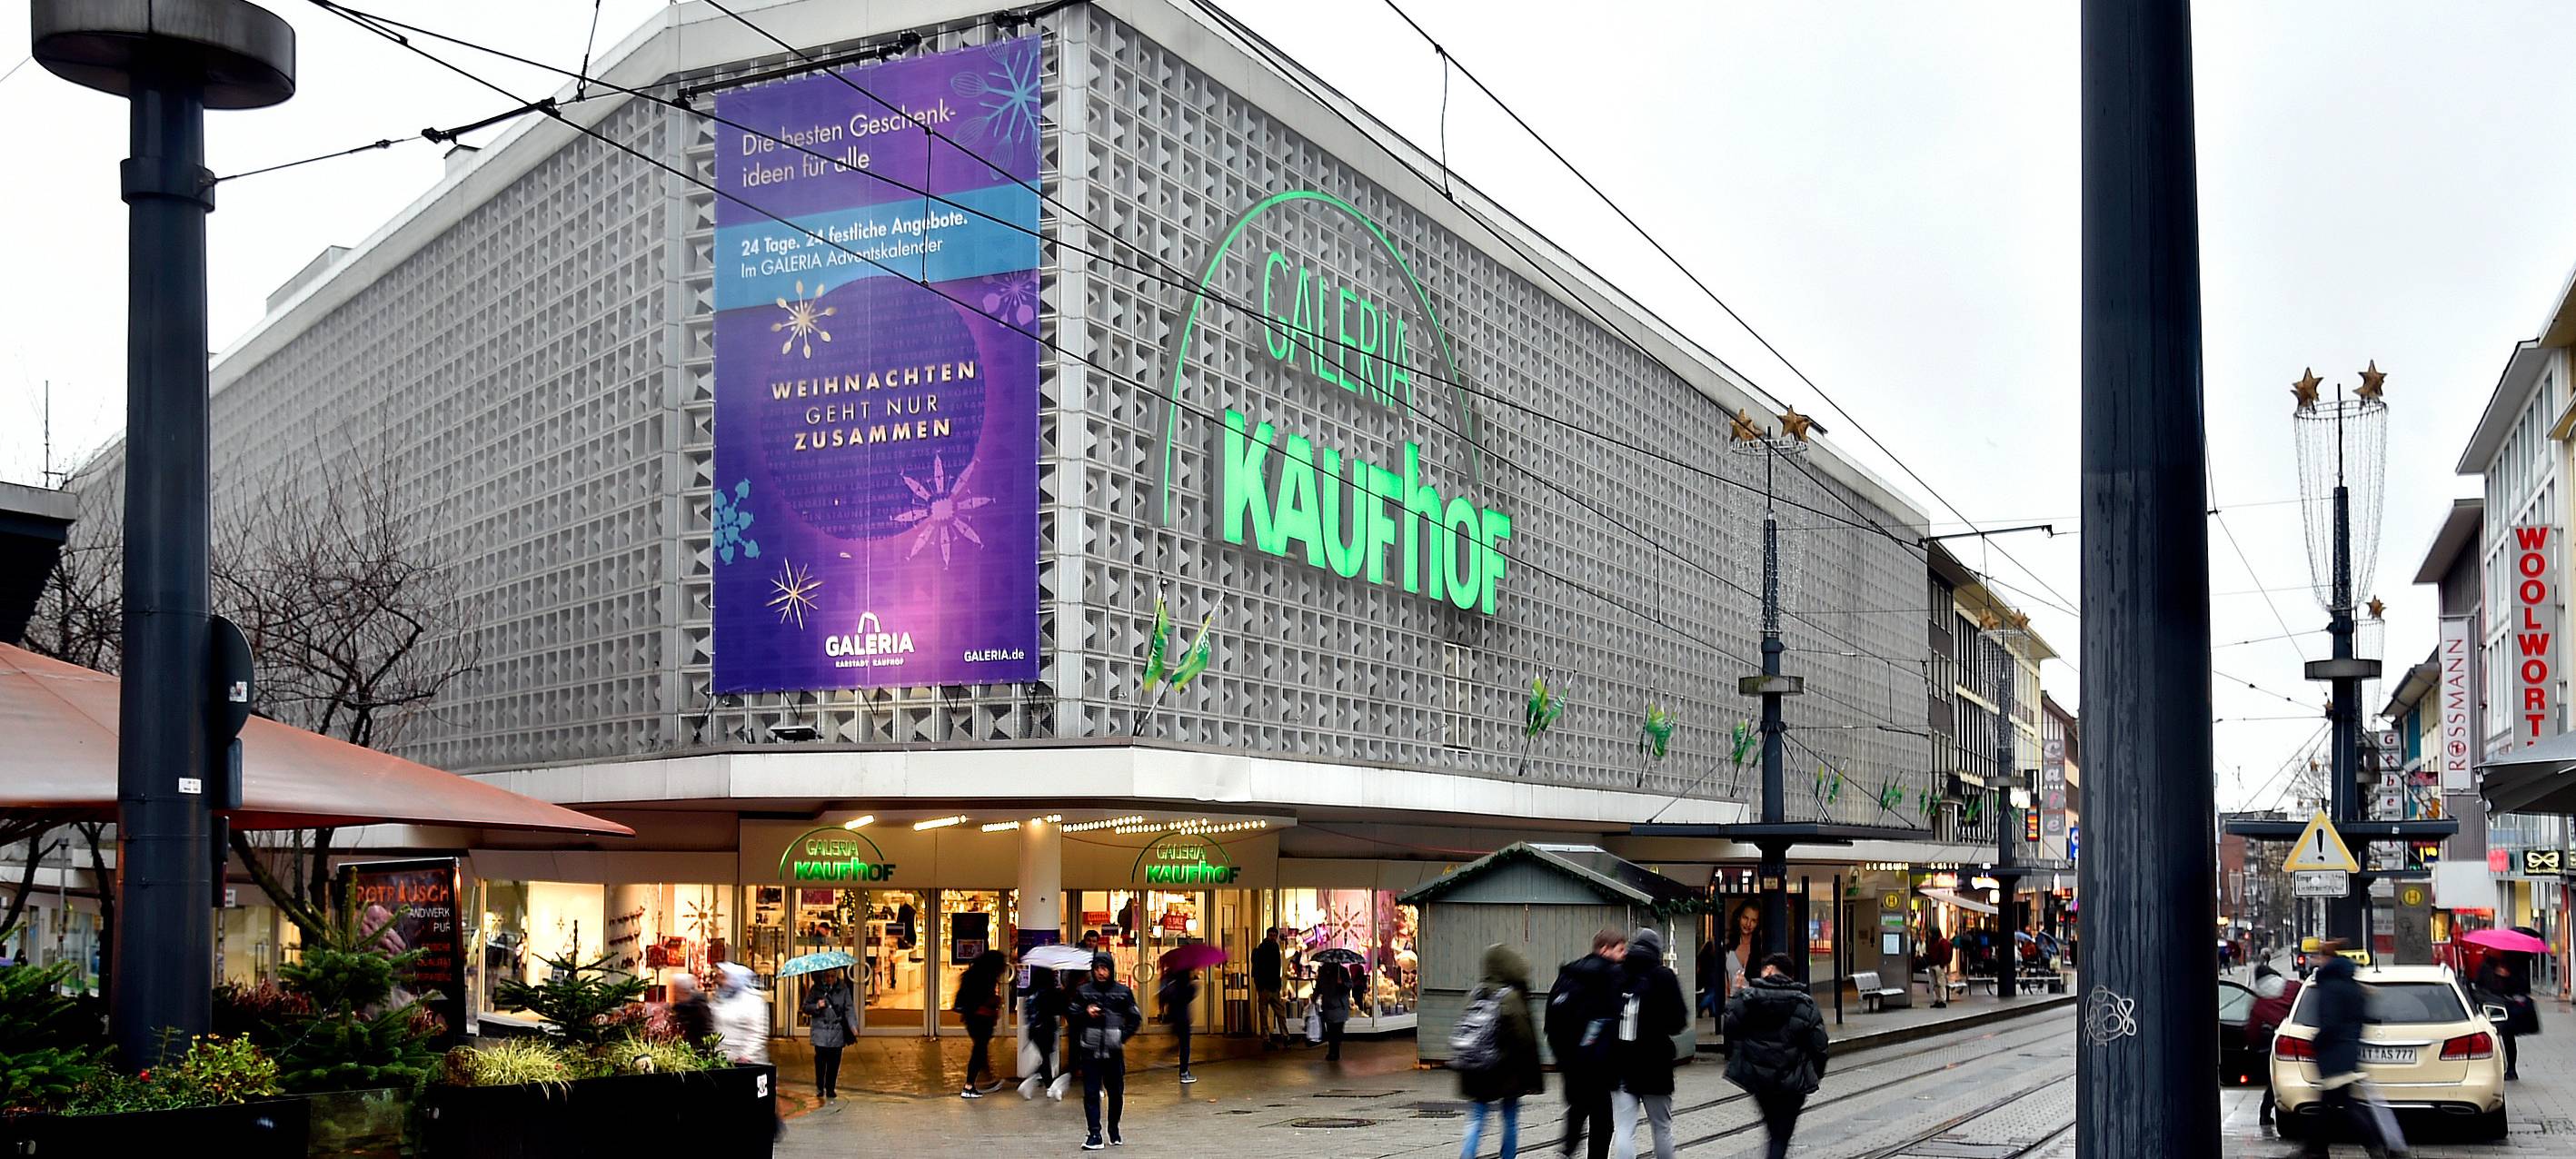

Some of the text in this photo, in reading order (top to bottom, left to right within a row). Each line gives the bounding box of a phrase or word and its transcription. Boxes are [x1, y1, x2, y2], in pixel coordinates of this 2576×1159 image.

[742, 99, 957, 155] Die besten Geschenk-
[742, 145, 870, 188] ideen für alle
[741, 211, 969, 257] 24 Tage. 24 festliche Angebote.
[741, 238, 944, 279] Im GALERIA Adventskalender
[1263, 251, 1414, 418] GALERIA
[771, 361, 976, 400] WEIHNACHTEN
[805, 401, 870, 425] GEHT
[887, 394, 938, 417] NUR
[793, 418, 951, 451] ZUSAMMEN
[825, 632, 915, 657] GALERIA
[964, 647, 1025, 662] GALERIA.de
[2516, 527, 2550, 746] WOOLWORT
[835, 657, 904, 668] KARSTADT KAUFHOF
[2446, 639, 2467, 771] ROSSMANN
[805, 838, 859, 857] GALERIA
[1156, 843, 1207, 860] GALERIA
[2396, 1049, 2413, 1059] 777
